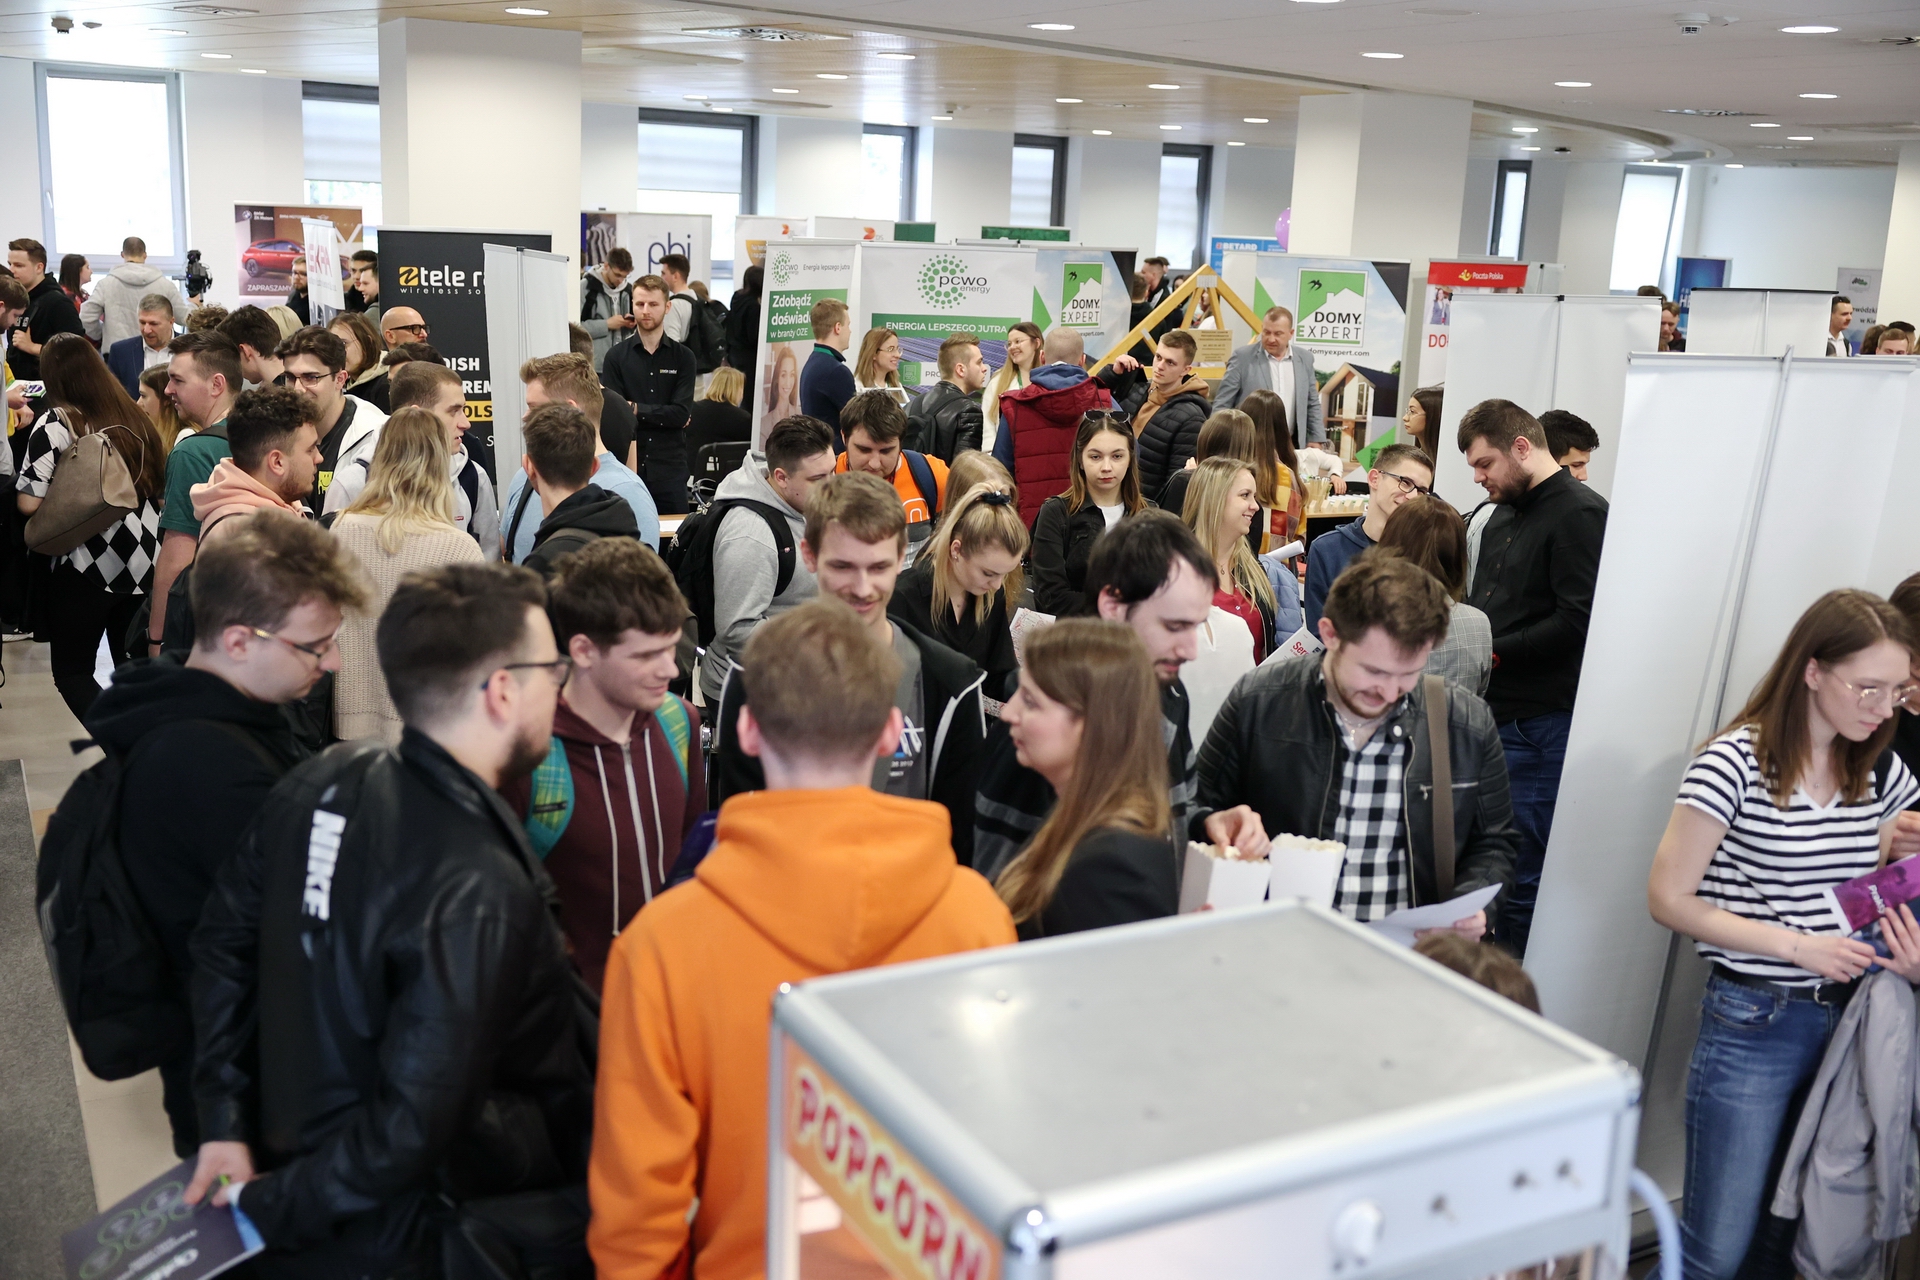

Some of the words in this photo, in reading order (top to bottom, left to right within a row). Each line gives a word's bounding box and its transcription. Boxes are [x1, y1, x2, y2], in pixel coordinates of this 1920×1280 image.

[1223, 242, 1258, 251] BETARD
[420, 264, 466, 287] tele
[939, 275, 988, 288] pcwo
[1472, 271, 1489, 280] Poczta
[1489, 272, 1504, 280] Polska
[247, 284, 292, 292] ZAPRASZAMY
[959, 285, 991, 294] energy
[772, 293, 812, 310] Zdobądź
[1072, 299, 1100, 310] DOMY
[1061, 311, 1100, 323] EXPERT
[1314, 311, 1362, 325] DOMY
[777, 329, 796, 339] branży
[796, 327, 809, 337] OZE
[885, 321, 927, 331] ENERGIA
[928, 322, 977, 333] LEPSZEGO
[978, 324, 1008, 334] JUTRA
[1296, 325, 1362, 340] EXPERT
[301, 808, 347, 921] NIKE
[798, 1076, 985, 1280] POPCORN
